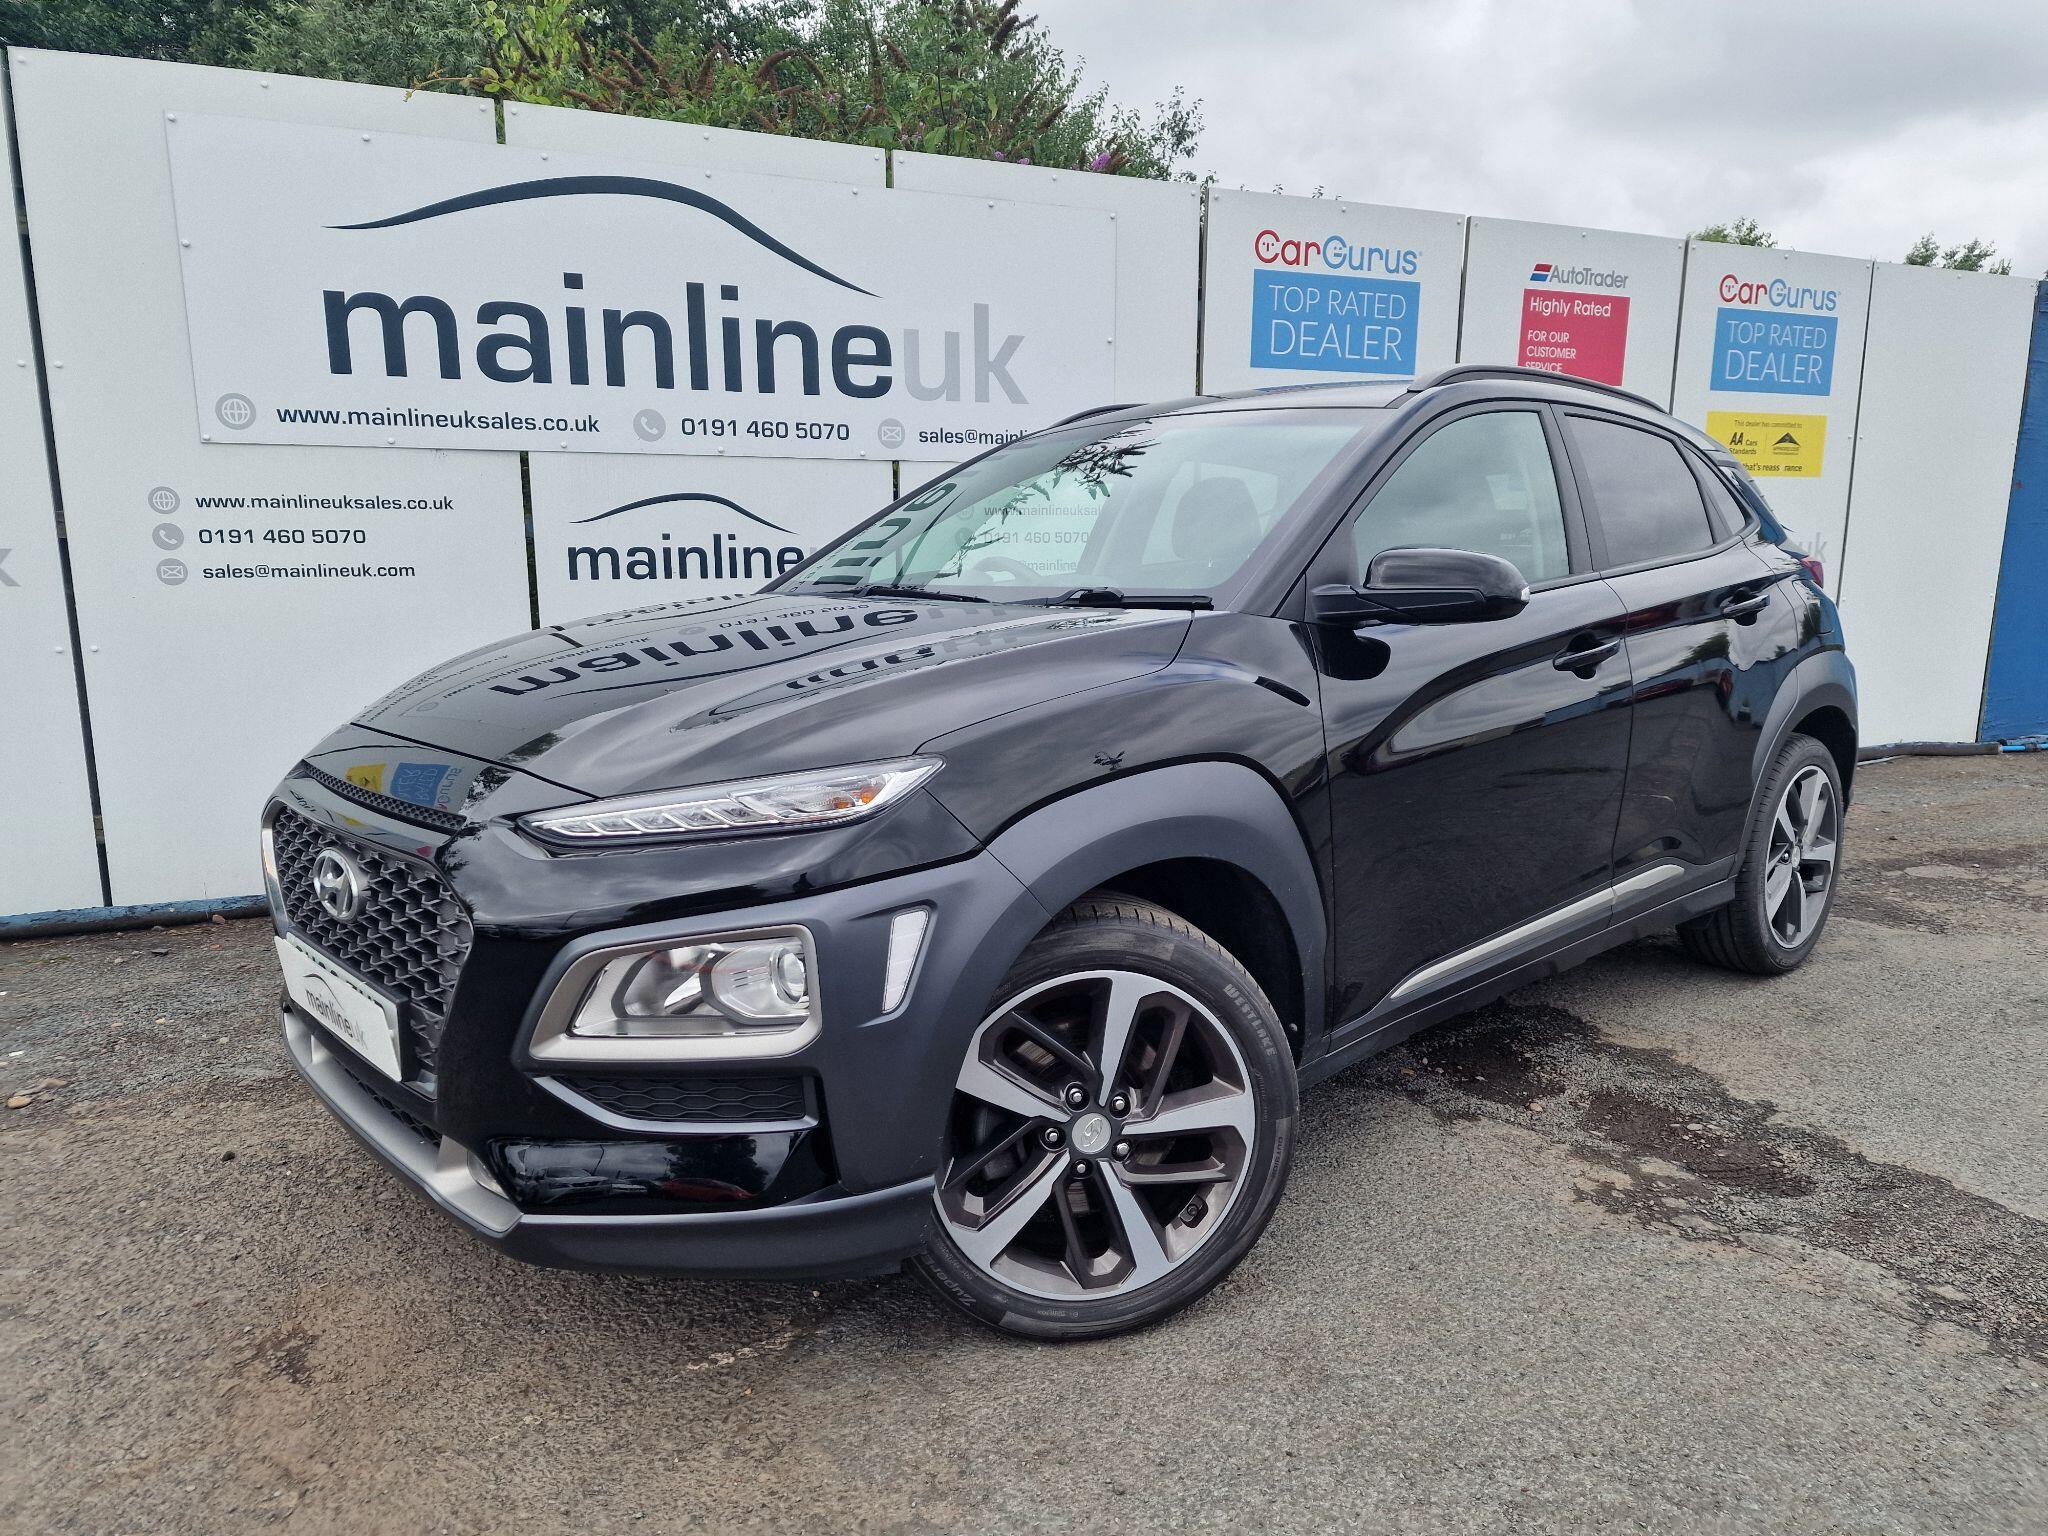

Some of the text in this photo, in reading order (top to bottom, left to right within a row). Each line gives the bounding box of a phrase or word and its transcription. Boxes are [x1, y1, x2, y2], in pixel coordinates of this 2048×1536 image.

[1254, 229, 1418, 276] CarGurus
[1549, 265, 1629, 289] AutoTrader
[1269, 284, 1407, 320] TOP RATED
[1719, 274, 1837, 311] CarGurus
[1530, 297, 1611, 317] Highly Rated
[1270, 319, 1402, 361] DEALER
[1527, 330, 1570, 343] FOR OUR
[1727, 320, 1827, 349] TOP RATED
[1526, 345, 1577, 359] CUSTOMER
[1525, 361, 1563, 373] SERVICE
[1725, 349, 1822, 384] DEALER
[275, 407, 601, 434] www.mainlineuksales.co.uk
[681, 417, 850, 441] 0191 460 5070
[919, 427, 1028, 446] sales@main
[1729, 432, 1744, 446] AA
[195, 495, 455, 511] www.mainlineuksales.co.uk
[198, 529, 367, 544] 0191 460 5070
[1024, 532, 1050, 544] 460
[1055, 531, 1088, 544] 5070
[567, 533, 818, 580] mainline
[202, 564, 416, 579] sales@mainlineuk.com
[1223, 983, 1278, 1057] WESTLAKE
